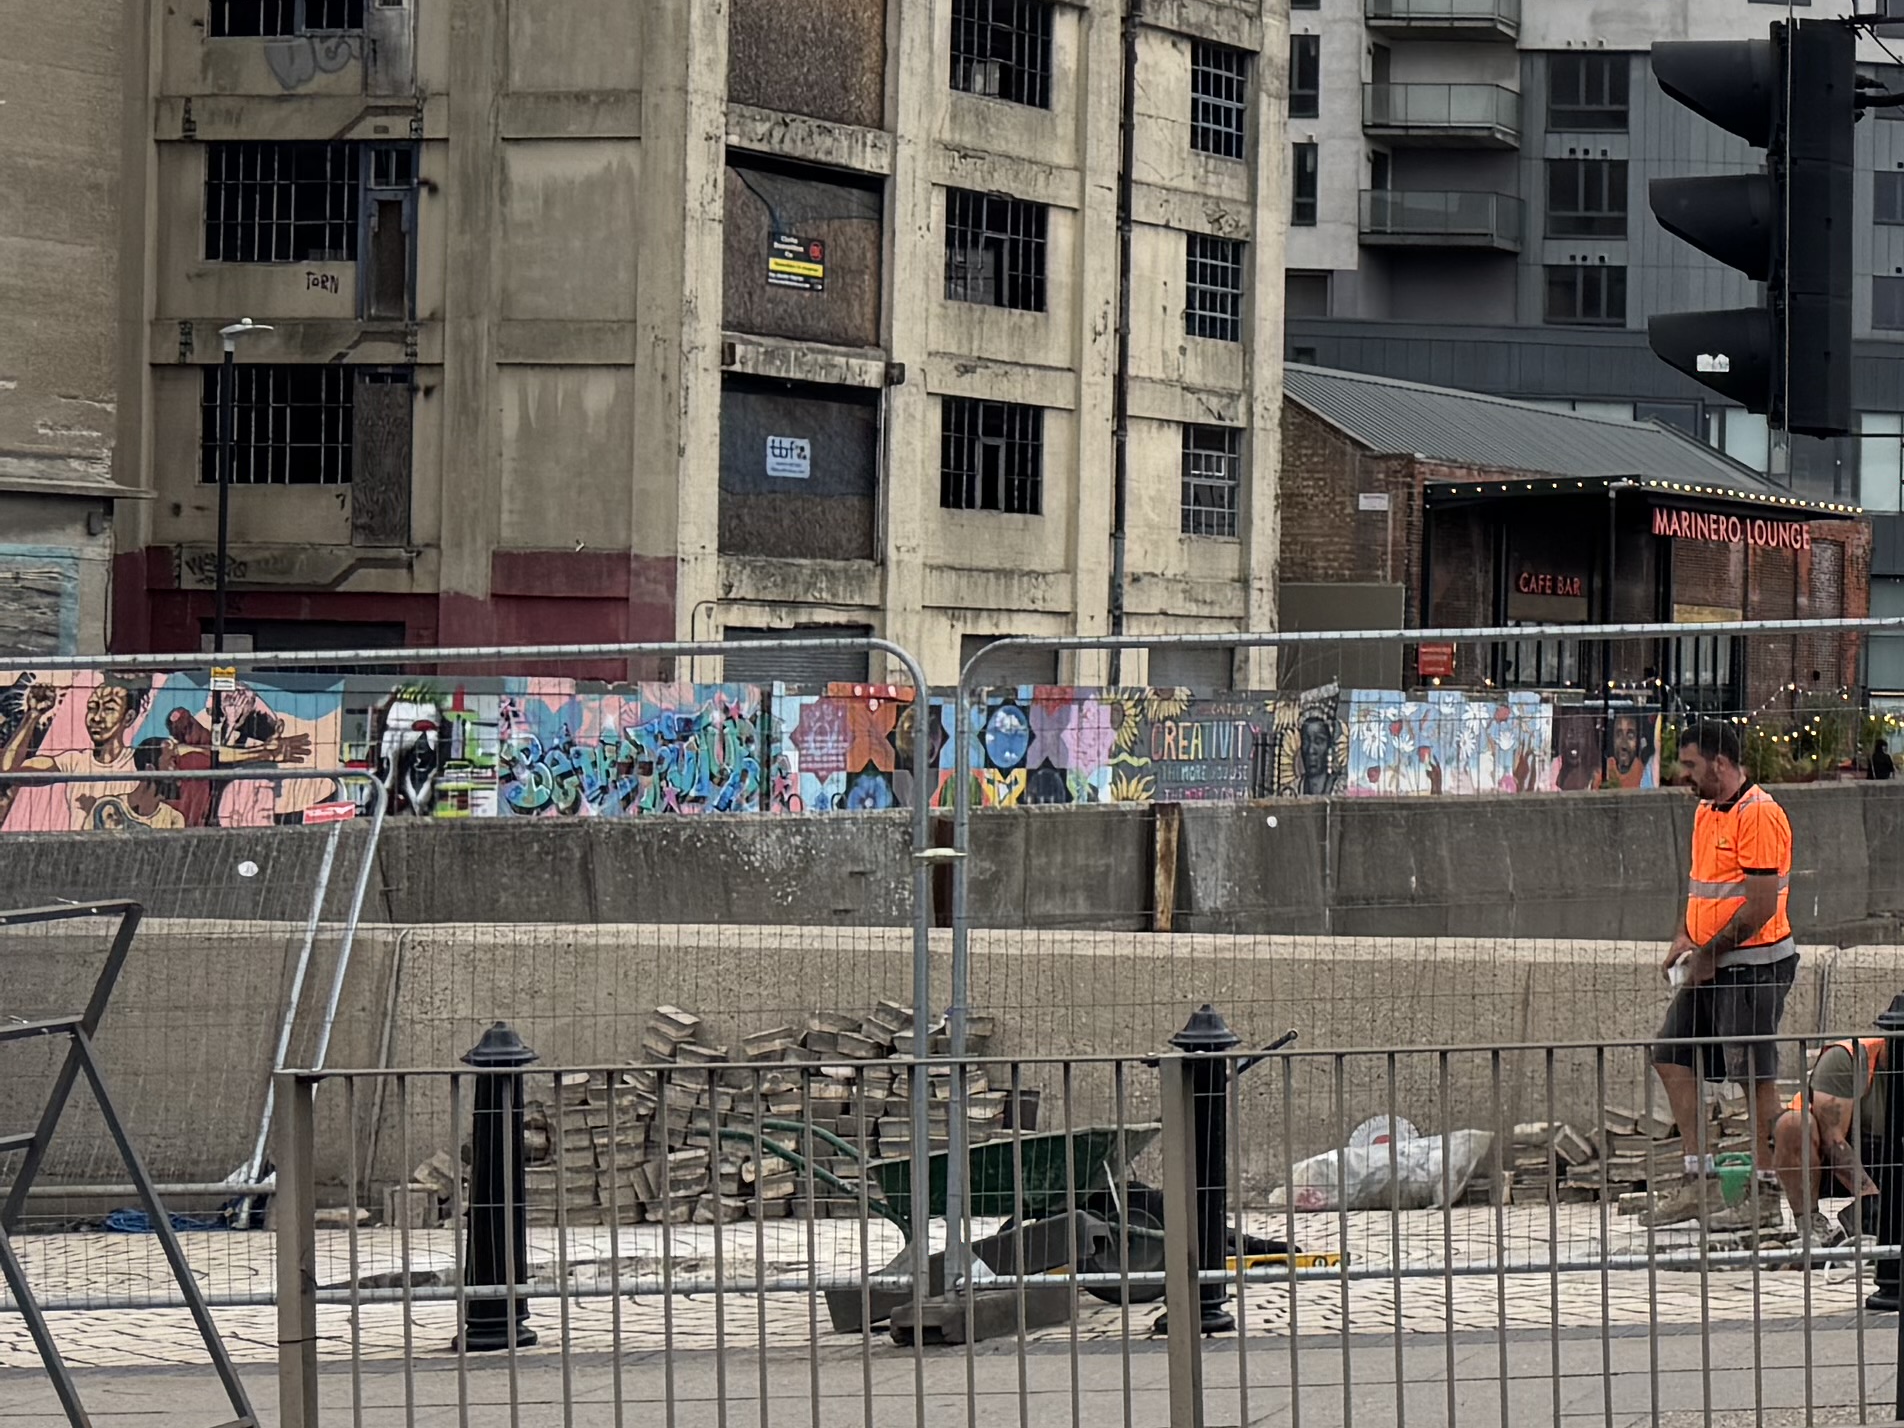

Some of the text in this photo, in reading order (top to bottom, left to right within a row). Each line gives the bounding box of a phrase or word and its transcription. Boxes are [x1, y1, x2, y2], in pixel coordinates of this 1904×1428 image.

[305, 271, 339, 293] TORN
[1653, 507, 1811, 550] MARINERO LOUNGE
[1519, 573, 1581, 596] CAFE BAR
